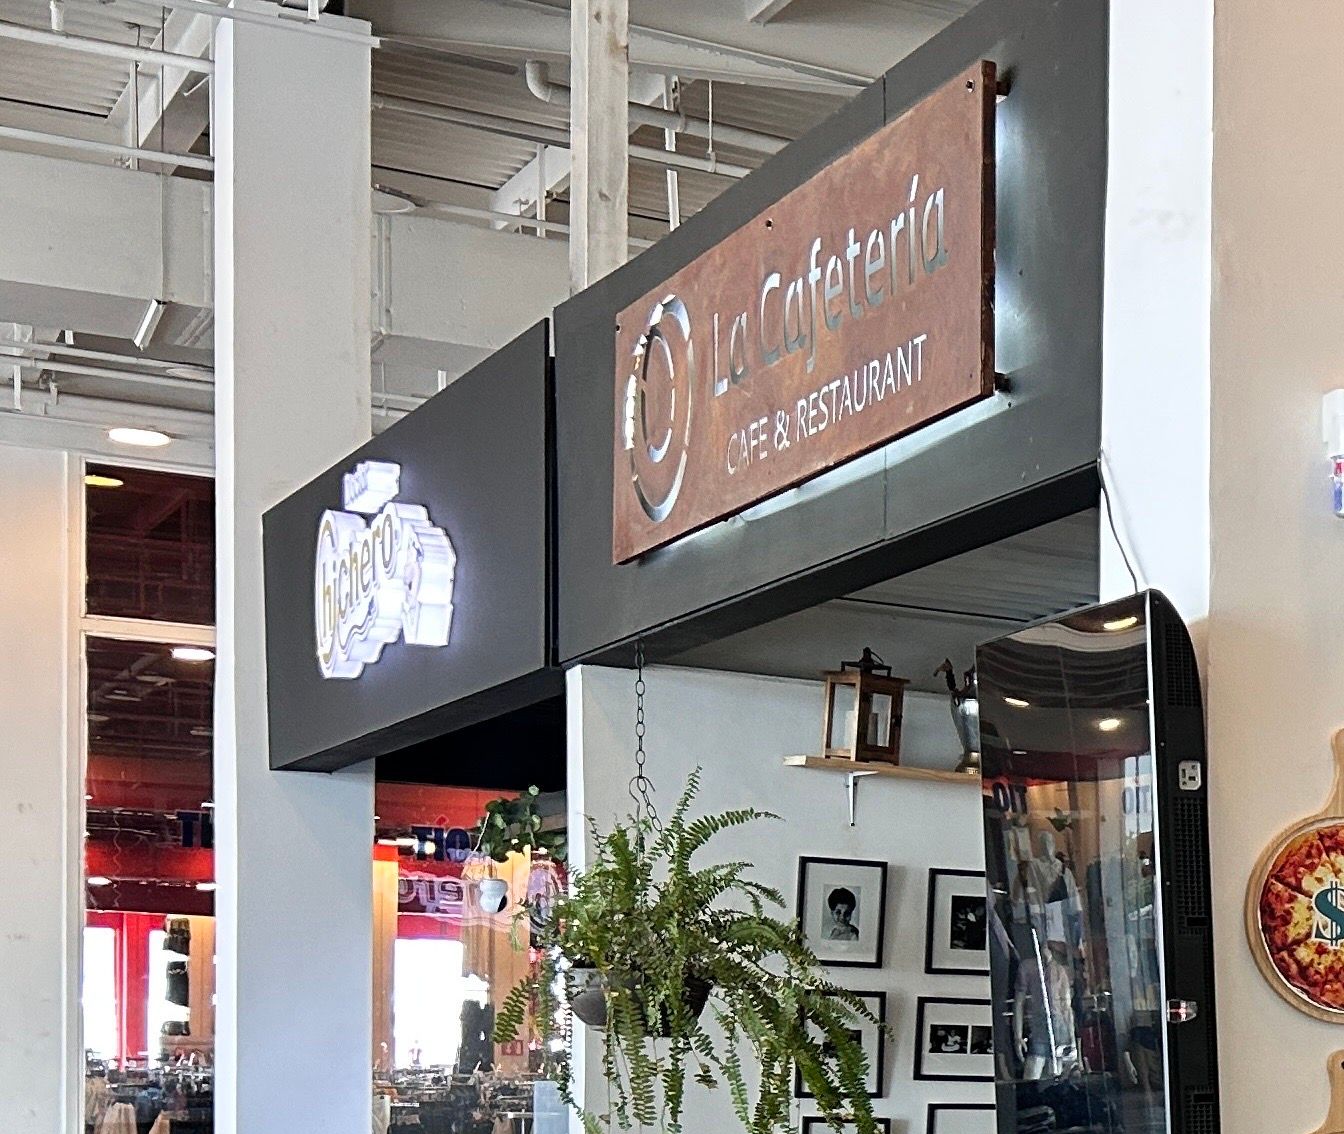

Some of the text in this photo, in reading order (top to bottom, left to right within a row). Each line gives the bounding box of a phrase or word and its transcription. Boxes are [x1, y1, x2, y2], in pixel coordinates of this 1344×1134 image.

[712, 173, 949, 397] La Cafetería
[726, 333, 928, 475] CAFE & RESTAURANT
